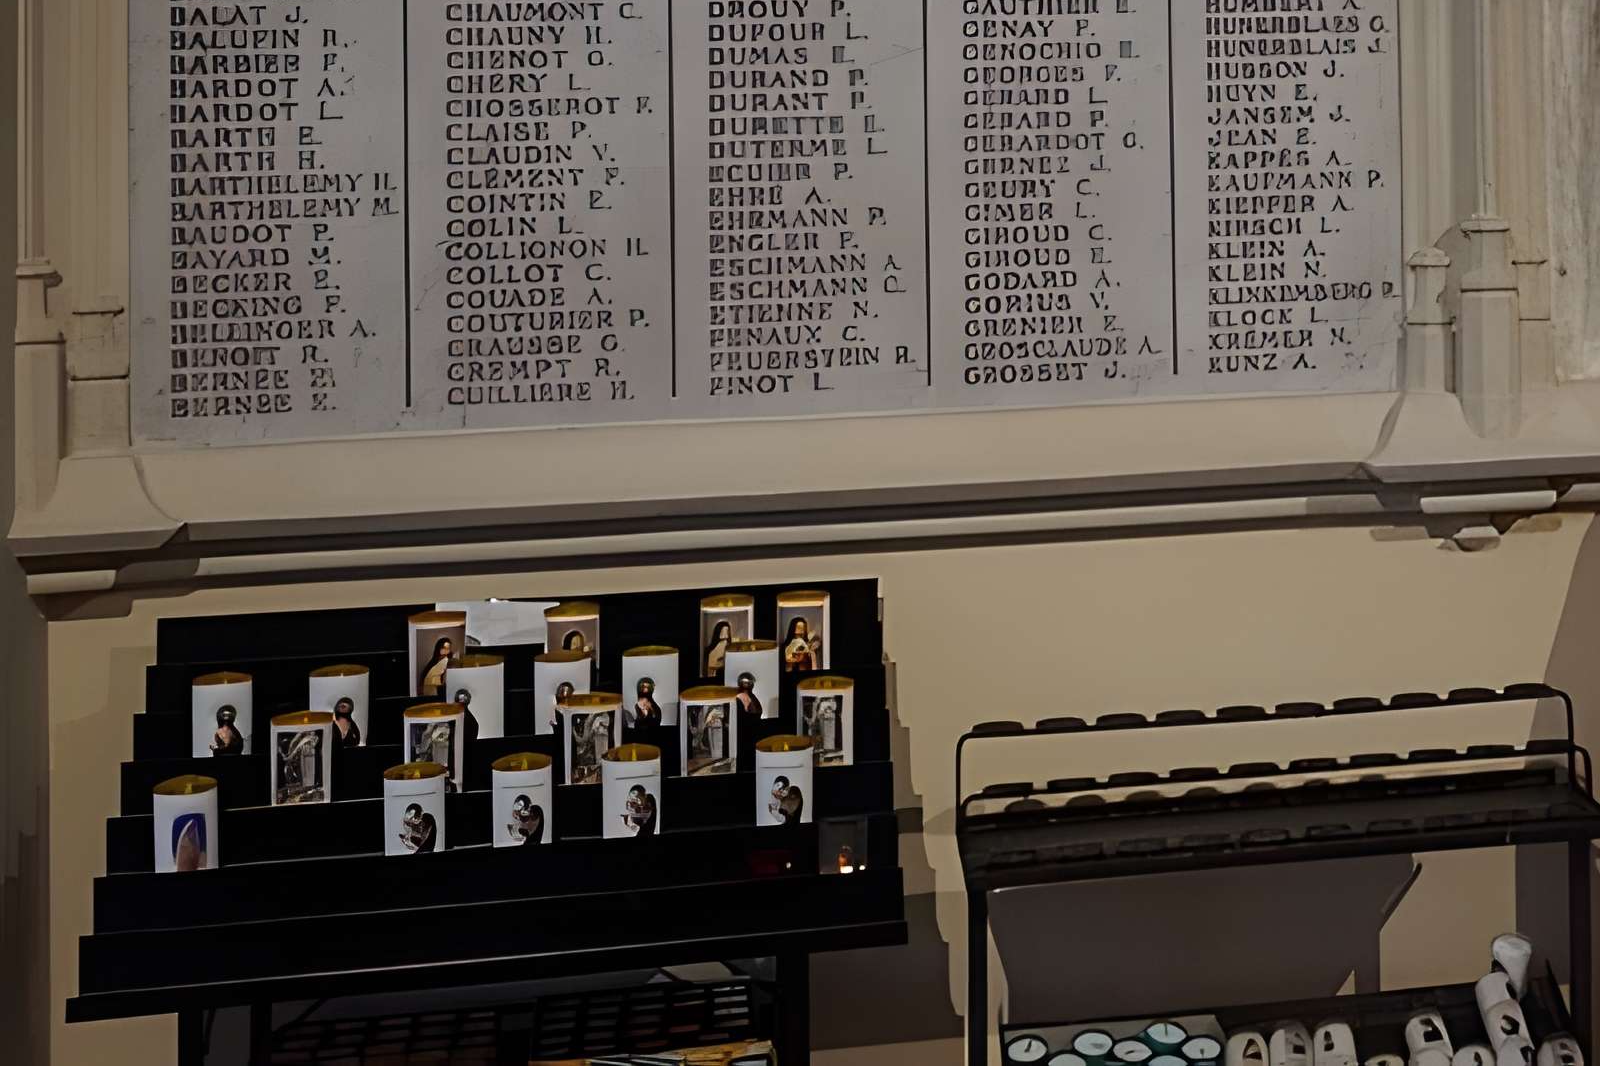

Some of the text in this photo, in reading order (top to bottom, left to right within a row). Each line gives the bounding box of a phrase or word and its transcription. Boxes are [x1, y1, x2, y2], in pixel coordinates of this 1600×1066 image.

[447, 145, 572, 165] CLAUDIN
[446, 216, 536, 238] COLIN
[446, 263, 611, 285] COLLOT C.
